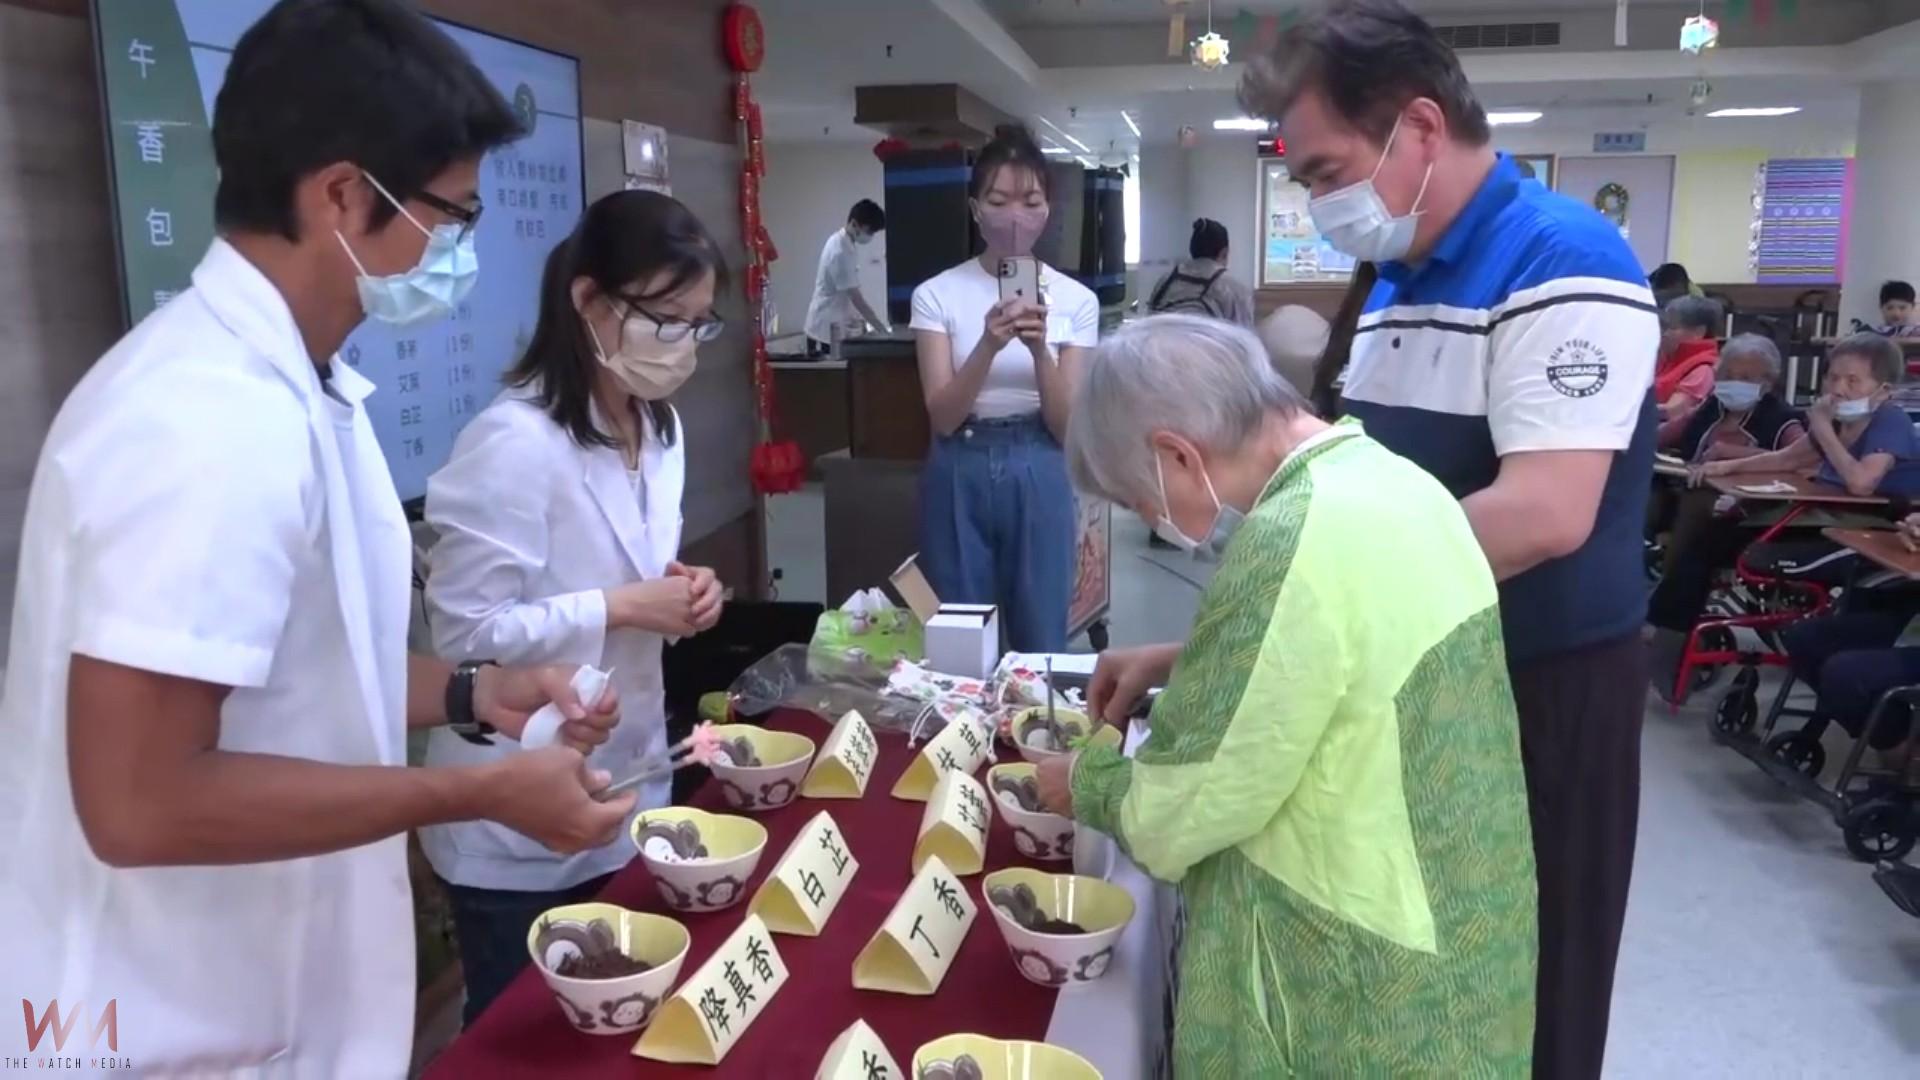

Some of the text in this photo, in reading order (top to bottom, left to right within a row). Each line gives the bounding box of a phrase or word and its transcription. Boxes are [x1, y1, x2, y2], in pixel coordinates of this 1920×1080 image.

[1555, 366, 1601, 377] COURAGE
[798, 828, 849, 909] 白芷
[909, 876, 966, 960] 丁香
[698, 935, 776, 1043] 降真香
